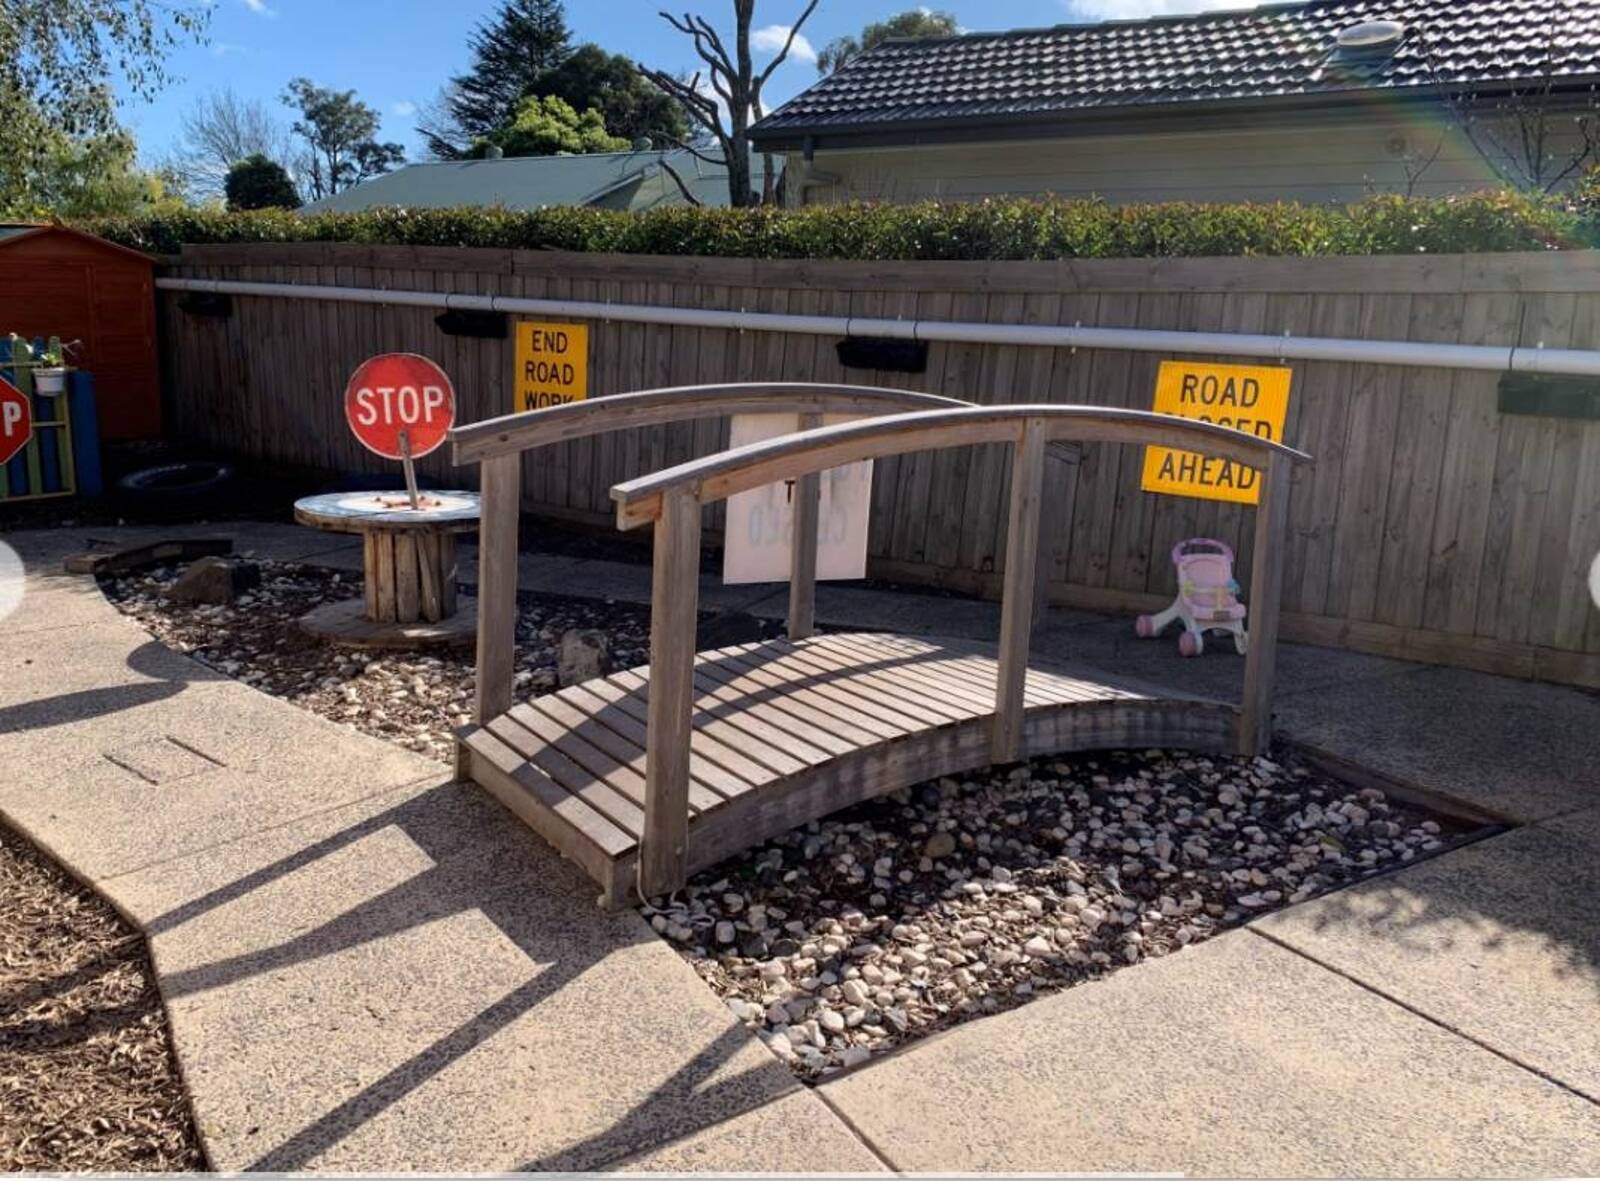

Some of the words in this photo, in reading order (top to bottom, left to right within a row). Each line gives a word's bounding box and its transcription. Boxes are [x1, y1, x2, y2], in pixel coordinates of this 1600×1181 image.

[532, 329, 568, 353] END
[525, 361, 575, 385] ROAD
[357, 386, 443, 426] STOP
[1180, 374, 1259, 407] ROAD
[1158, 452, 1256, 489] AHEAD
